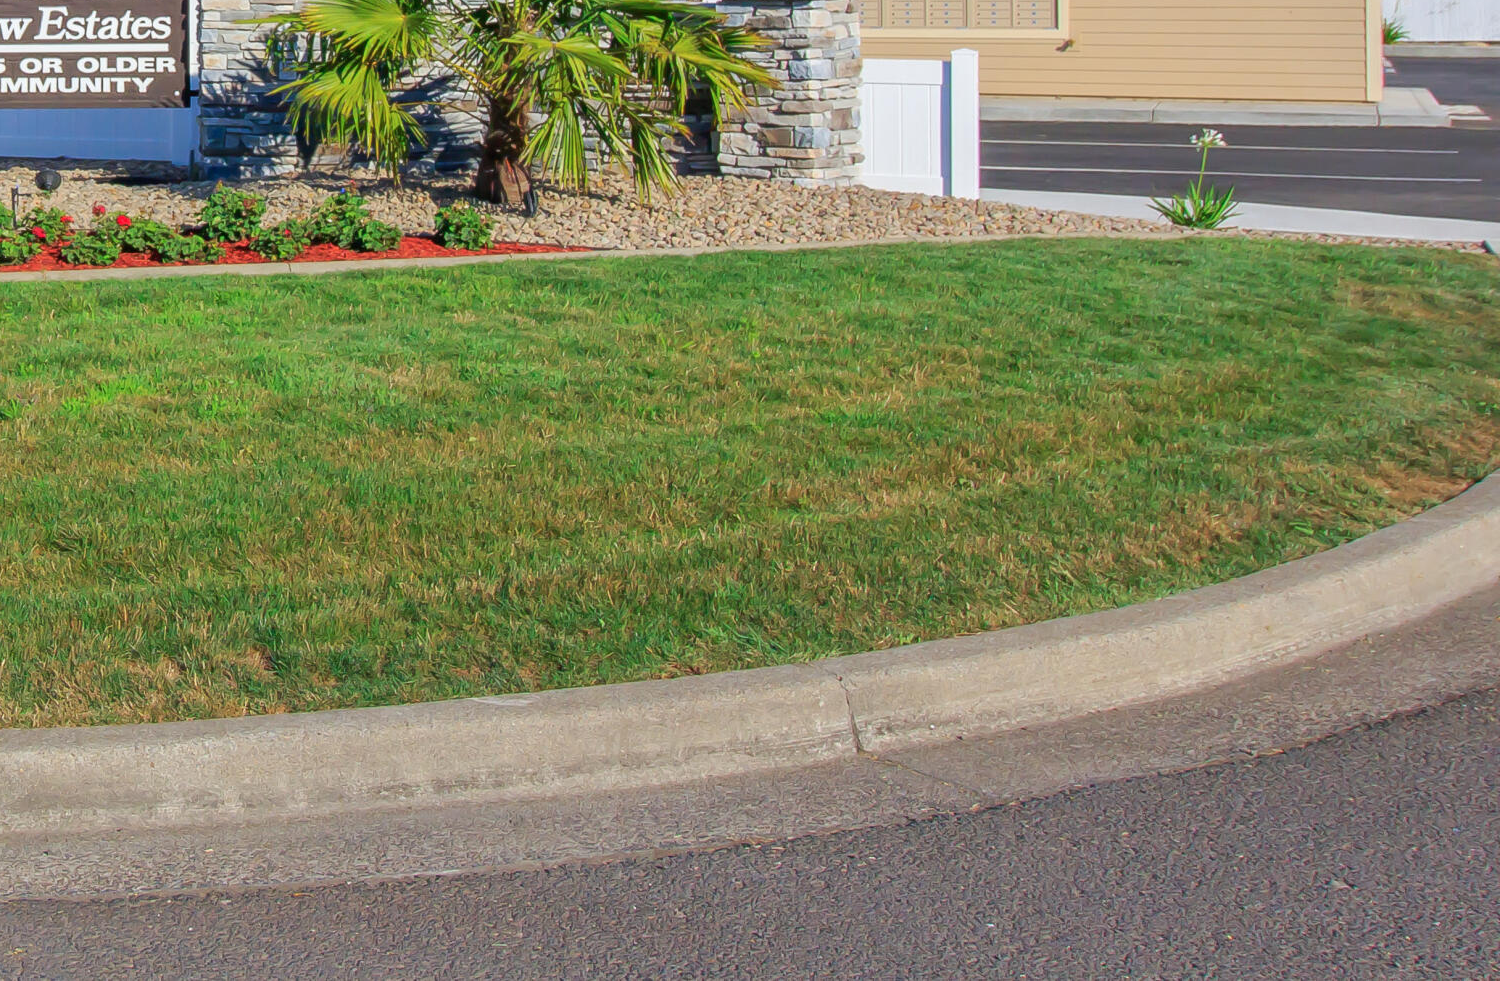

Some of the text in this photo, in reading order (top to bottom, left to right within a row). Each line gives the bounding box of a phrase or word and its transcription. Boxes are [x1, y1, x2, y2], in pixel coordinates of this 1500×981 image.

[33, 5, 172, 41] Estates
[19, 57, 63, 75] OR
[76, 56, 177, 74] OLDER
